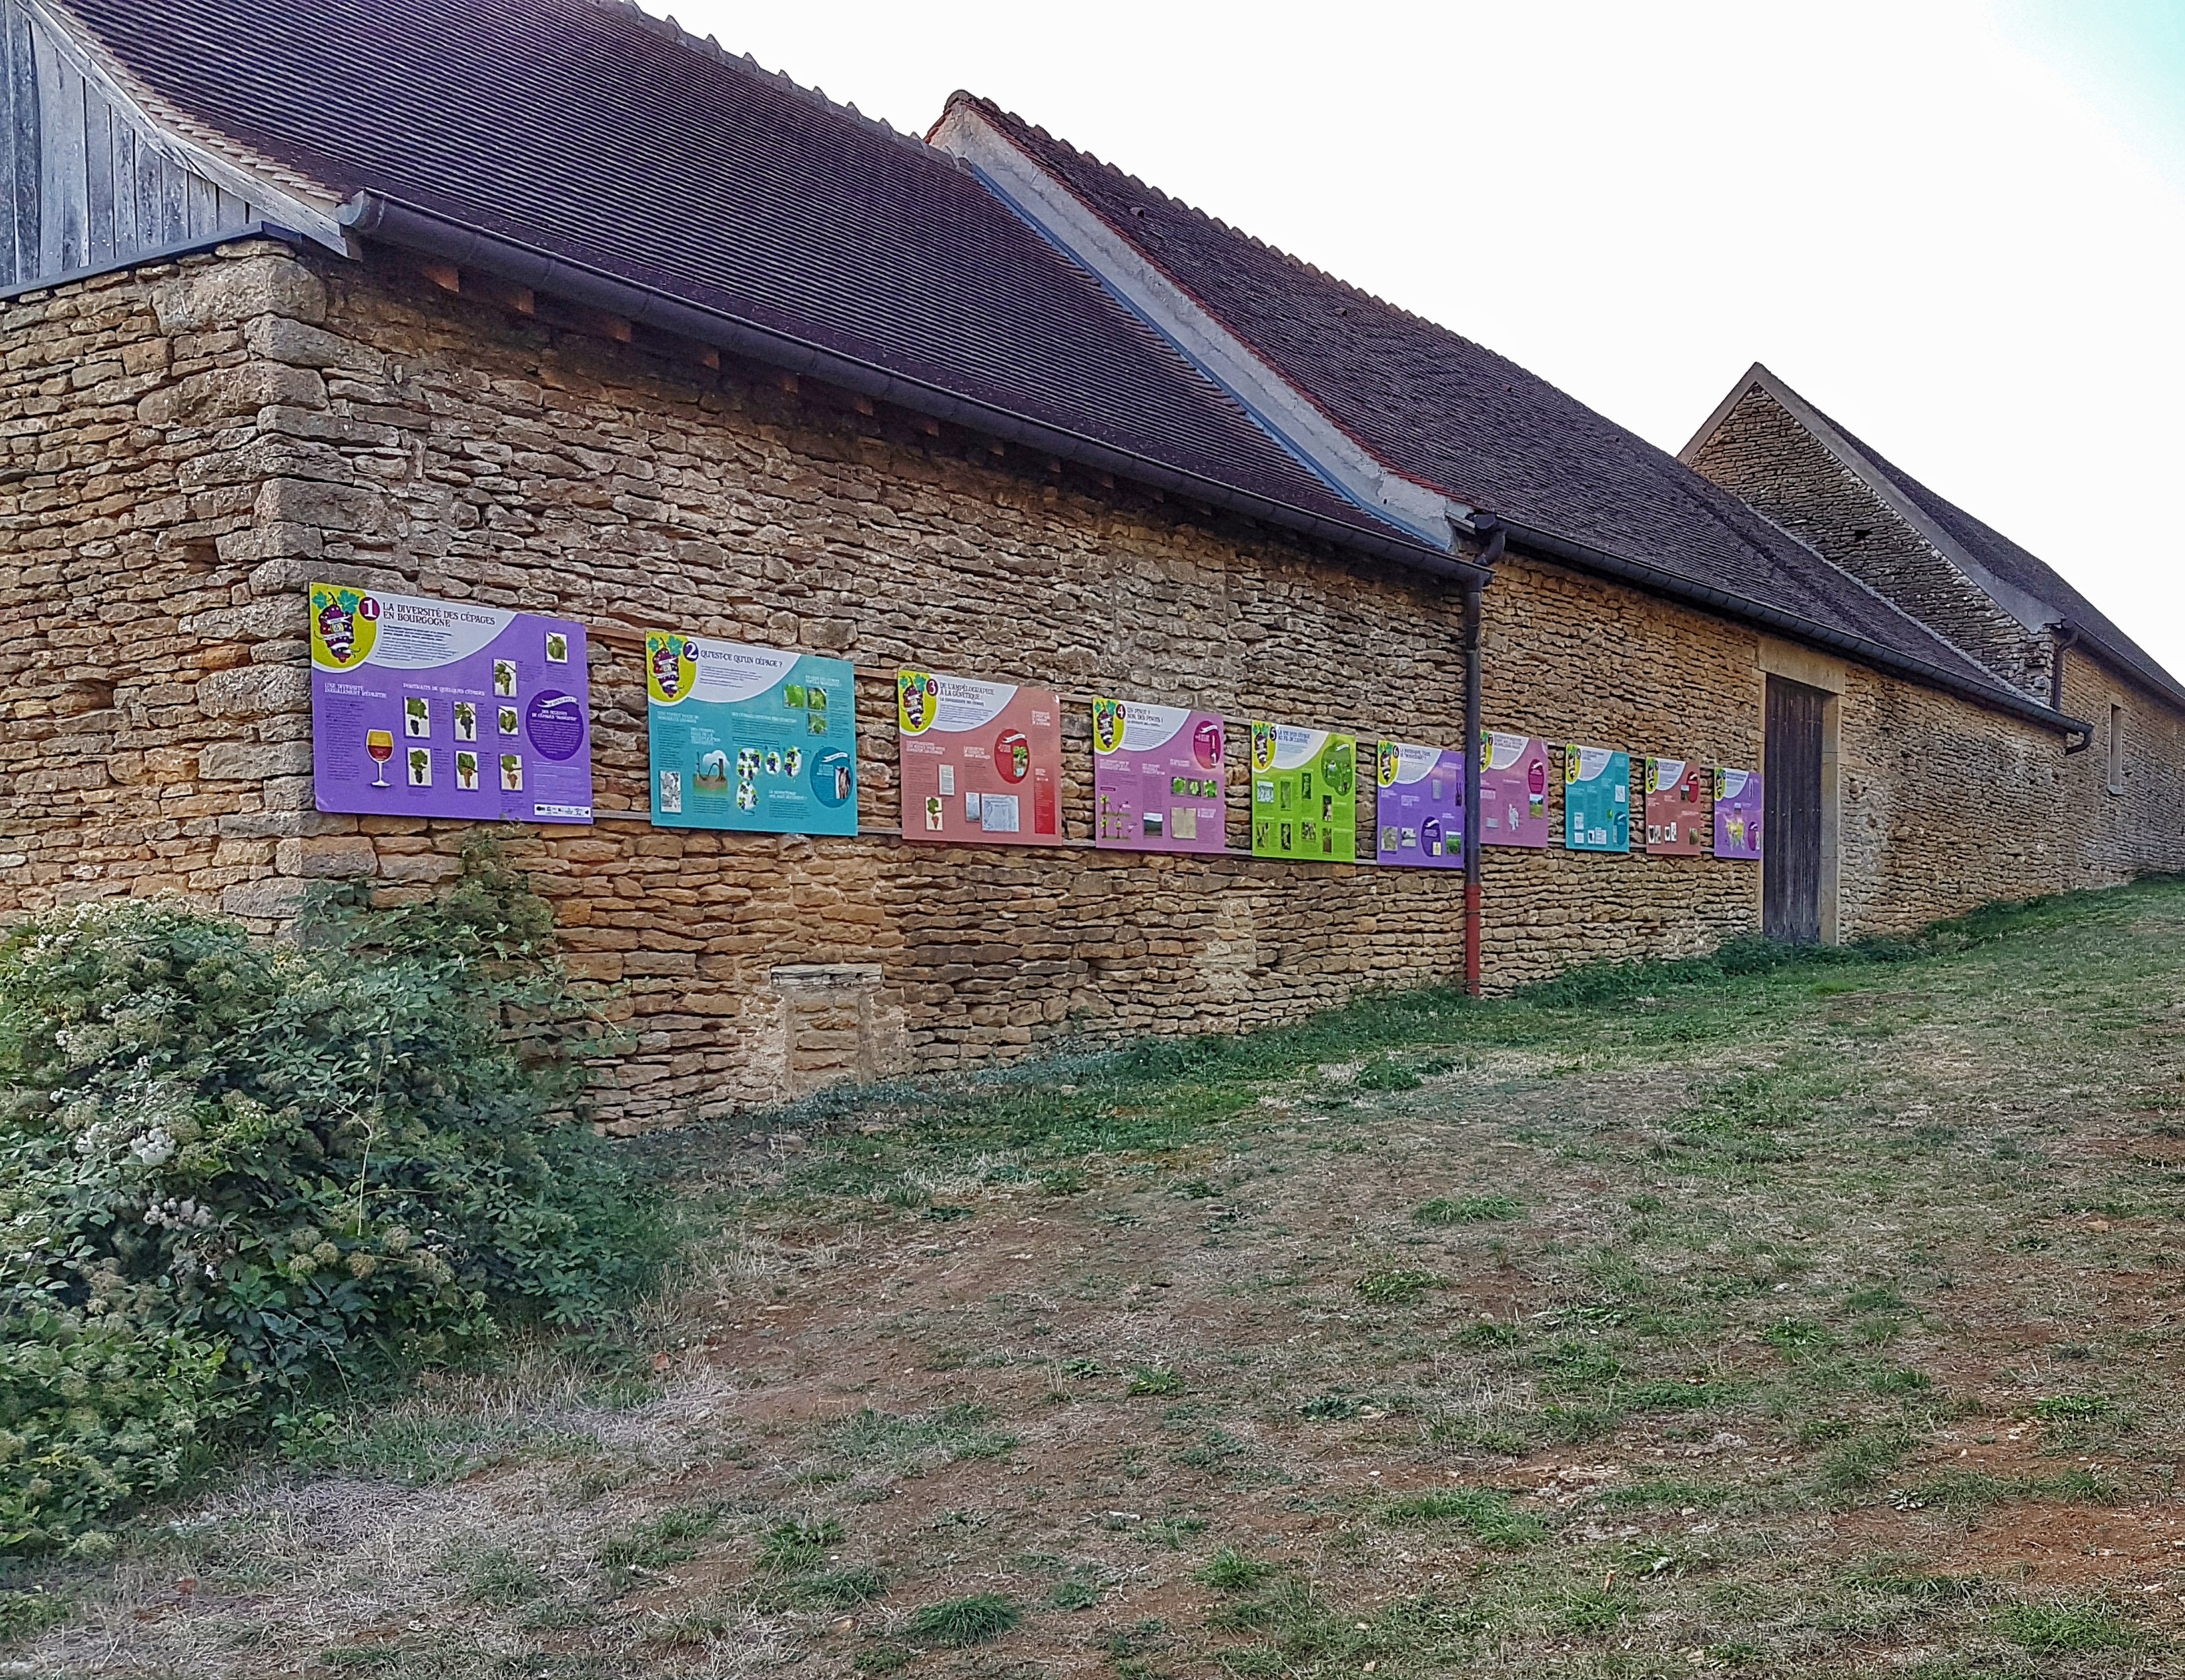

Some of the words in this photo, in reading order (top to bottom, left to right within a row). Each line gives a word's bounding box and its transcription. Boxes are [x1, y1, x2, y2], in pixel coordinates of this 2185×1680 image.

[364, 599, 377, 618] 1
[383, 602, 394, 611] LA
[397, 604, 441, 618] DIVERSITÉ
[444, 610, 458, 620] DES
[460, 612, 495, 625] CÉPAGES
[397, 614, 451, 627] BOURGOGNE
[686, 643, 697, 659] 2
[701, 650, 732, 661] QU'EST-CE
[734, 655, 753, 664] QU'UN
[755, 657, 778, 667] CÉPAGE
[929, 680, 936, 694] 3
[947, 684, 995, 695] L'AMPÉLOGRAPHIE
[1117, 705, 1124, 718] 4
[1271, 728, 1275, 739] 5
[1489, 735, 1492, 744] 7
[1394, 746, 1398, 758] 6
